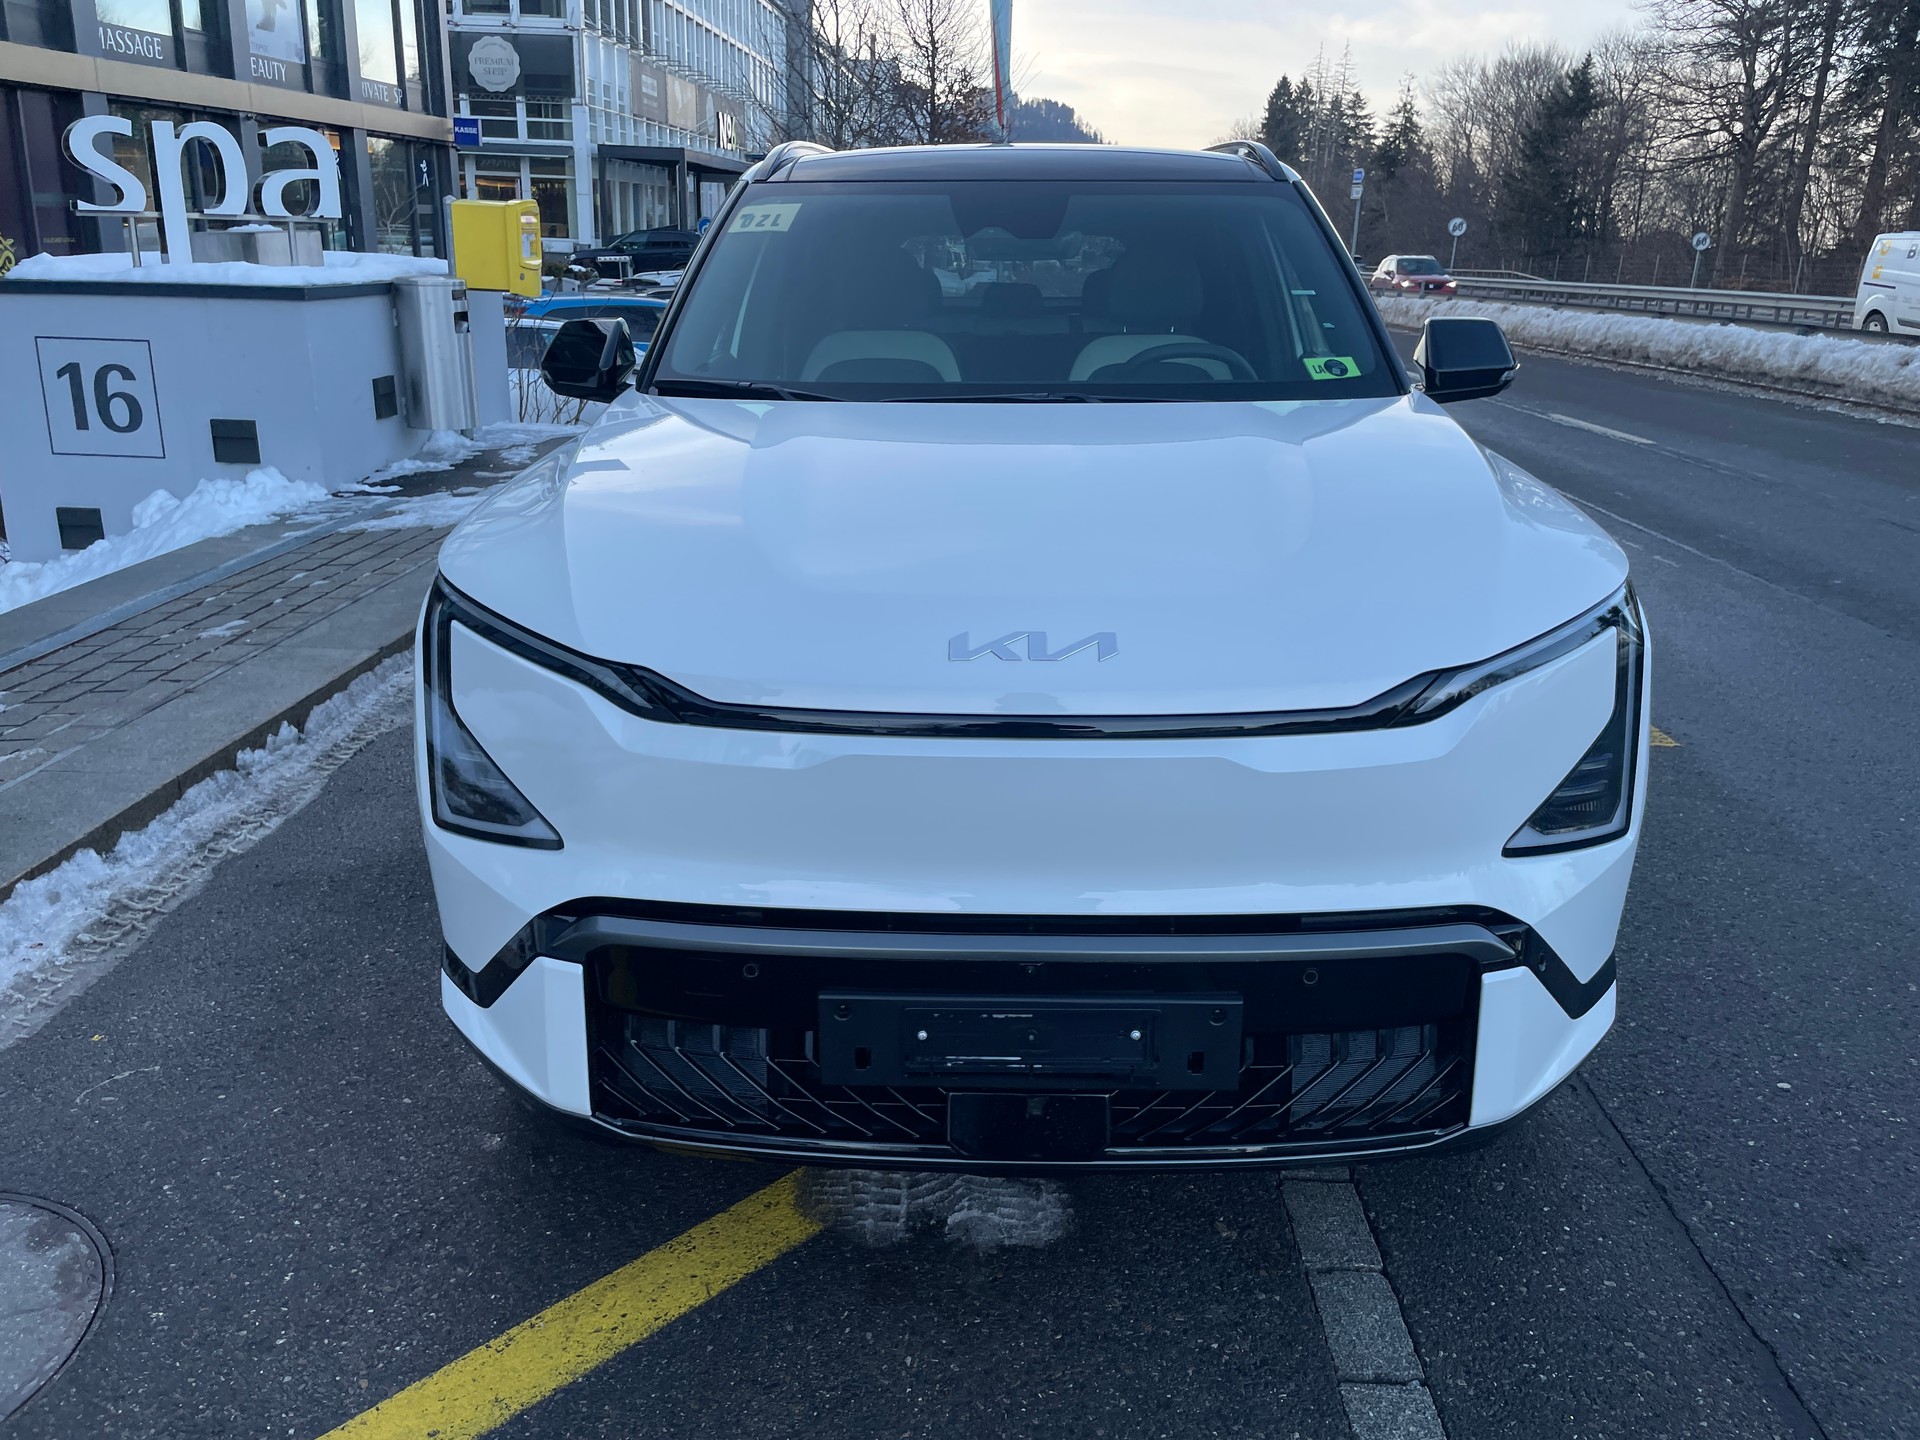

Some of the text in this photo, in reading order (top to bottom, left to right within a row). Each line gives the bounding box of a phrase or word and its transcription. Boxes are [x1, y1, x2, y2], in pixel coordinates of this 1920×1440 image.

[474, 56, 514, 66] PREMIUM
[454, 125, 478, 135] KASSE
[62, 114, 342, 265] spa
[56, 362, 143, 433] 16
[948, 630, 1120, 662] KIA
